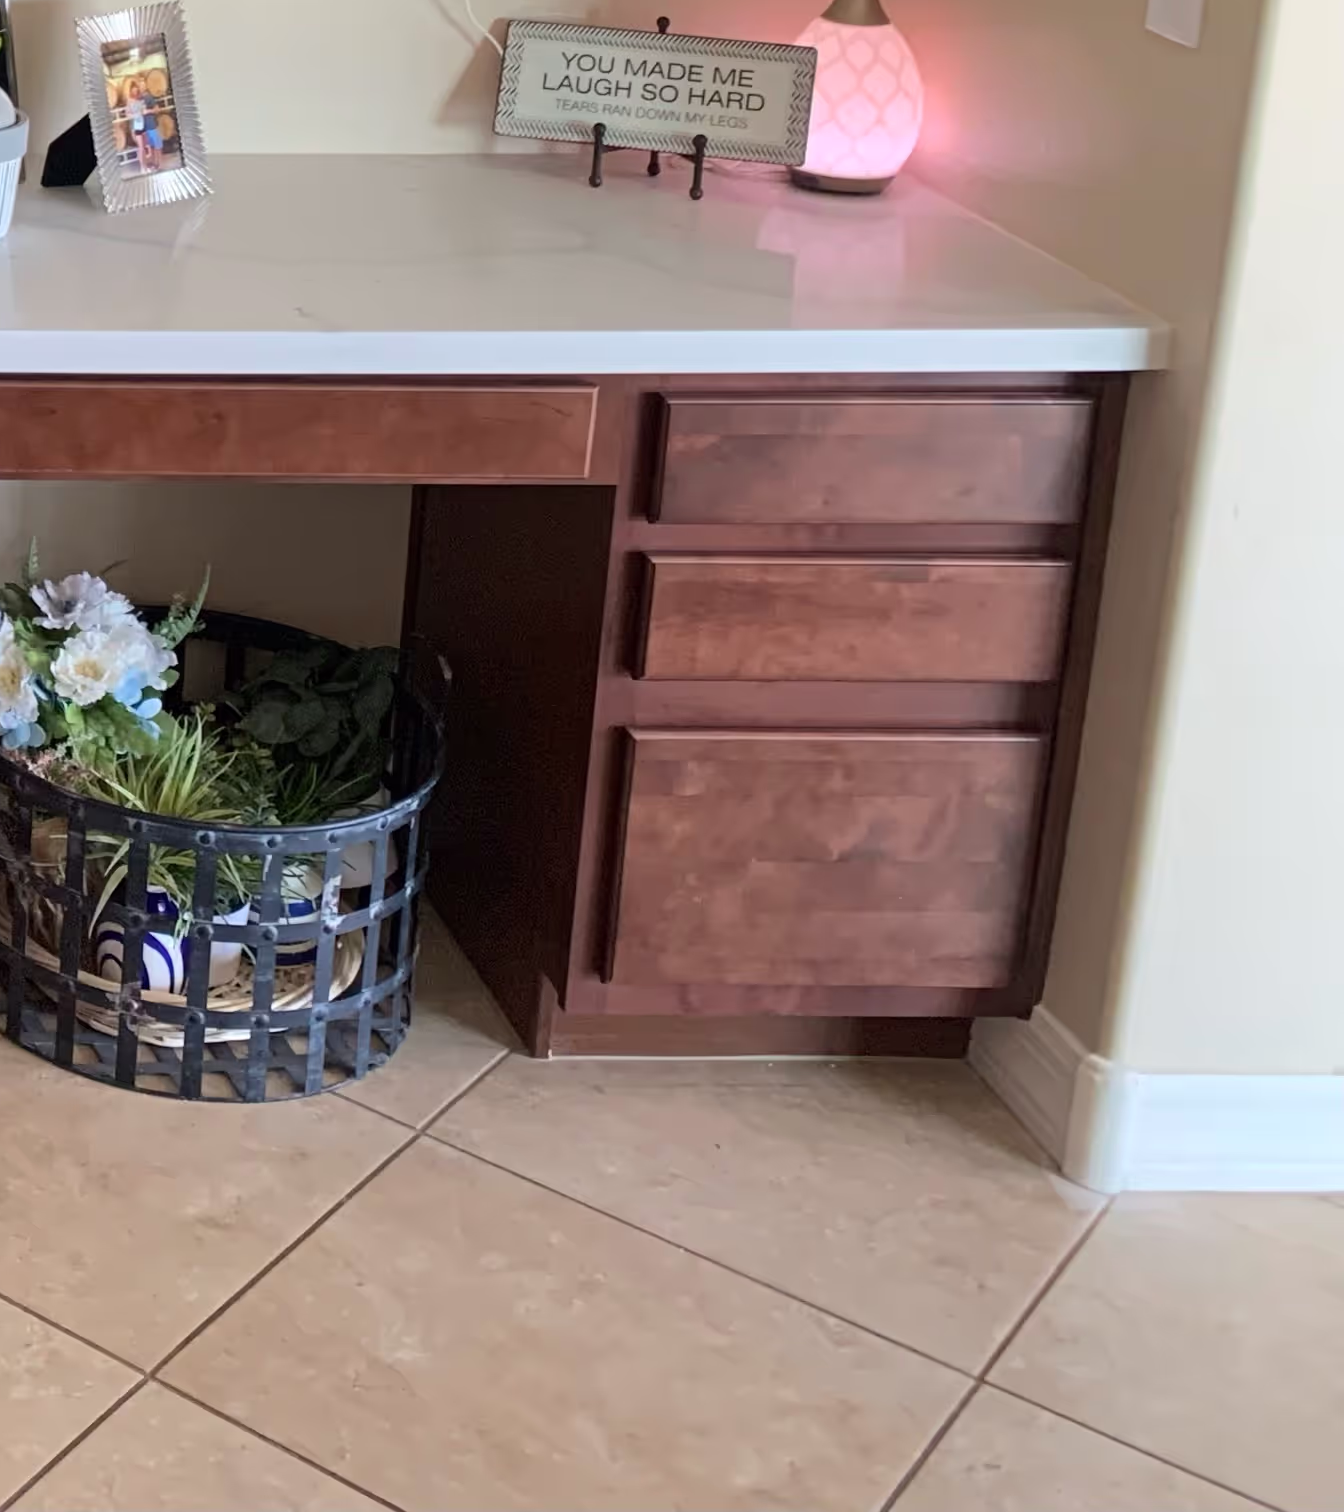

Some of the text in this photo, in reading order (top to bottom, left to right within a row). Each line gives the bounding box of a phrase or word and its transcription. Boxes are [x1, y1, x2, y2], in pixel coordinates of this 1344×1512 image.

[561, 51, 755, 88] YOU MADE ME
[542, 72, 765, 112] LAUGH SO HARD
[555, 98, 749, 130] TEARS RAN DOWN MY LEGS
